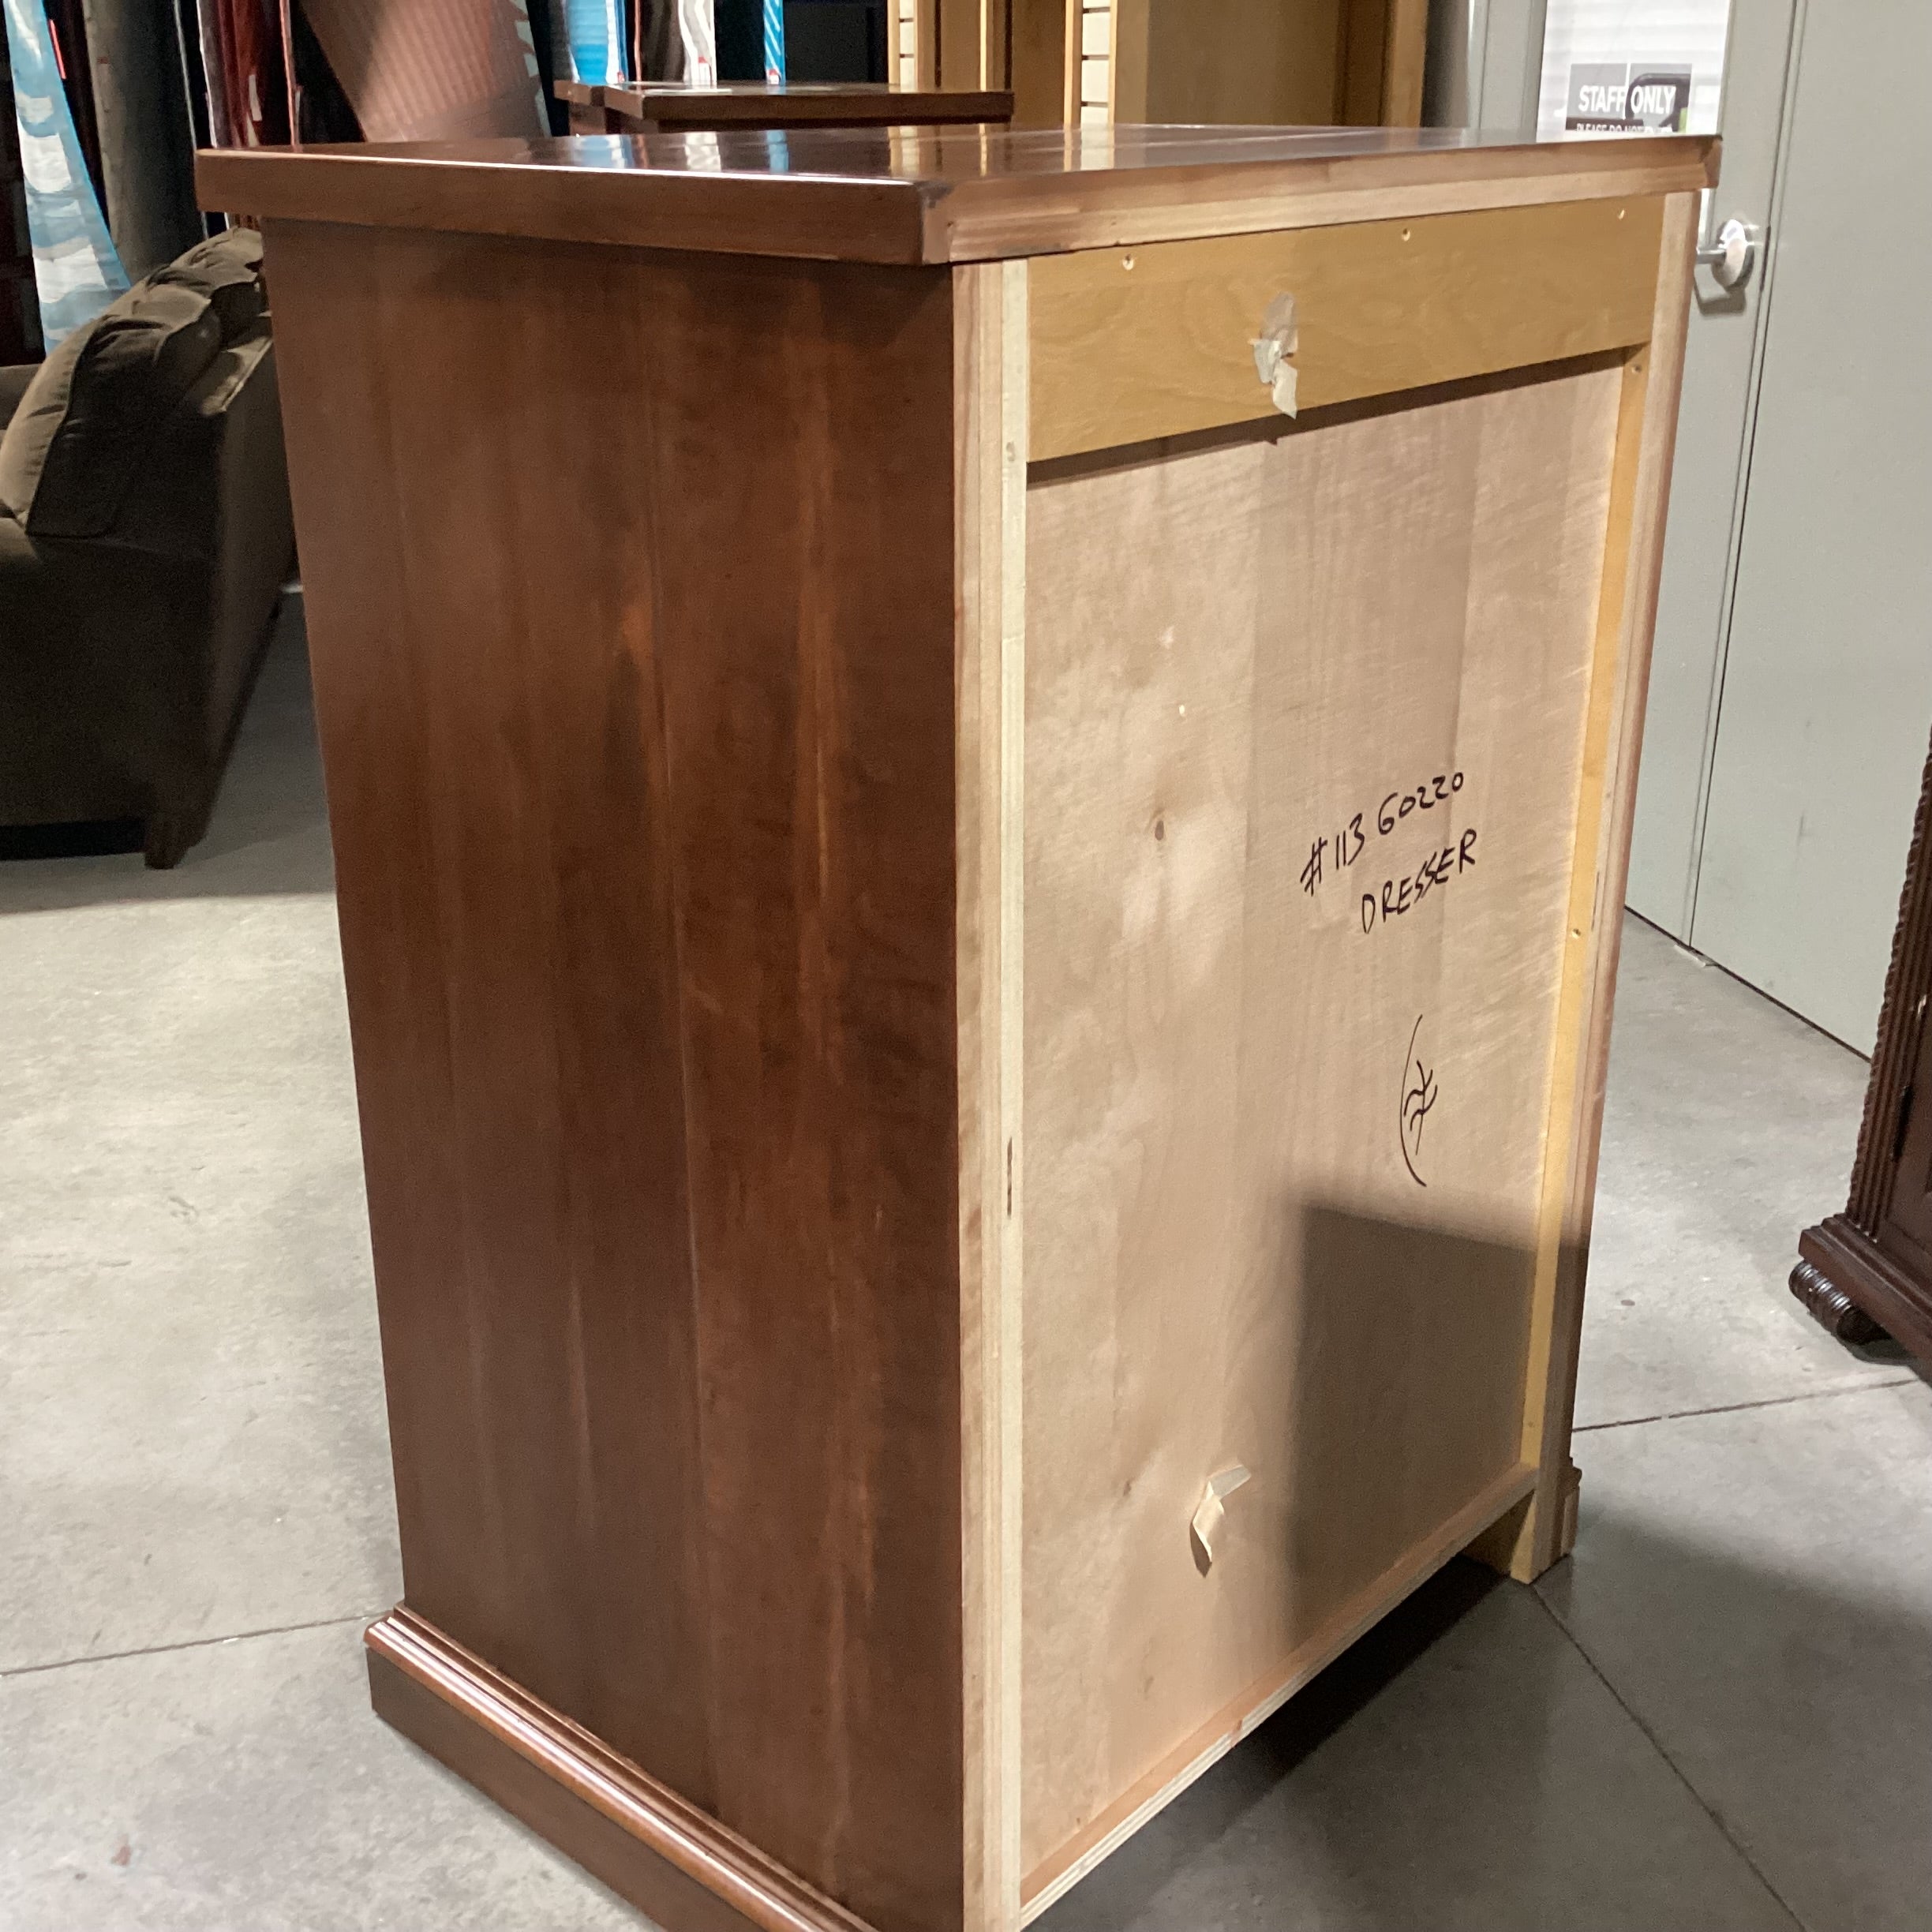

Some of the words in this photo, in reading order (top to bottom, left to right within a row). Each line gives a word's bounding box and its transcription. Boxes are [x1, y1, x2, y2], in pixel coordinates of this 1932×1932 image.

[1578, 84, 1626, 112] STAFF
[1631, 84, 1676, 114] ONLY
[1361, 829, 1477, 934] DRESSER
